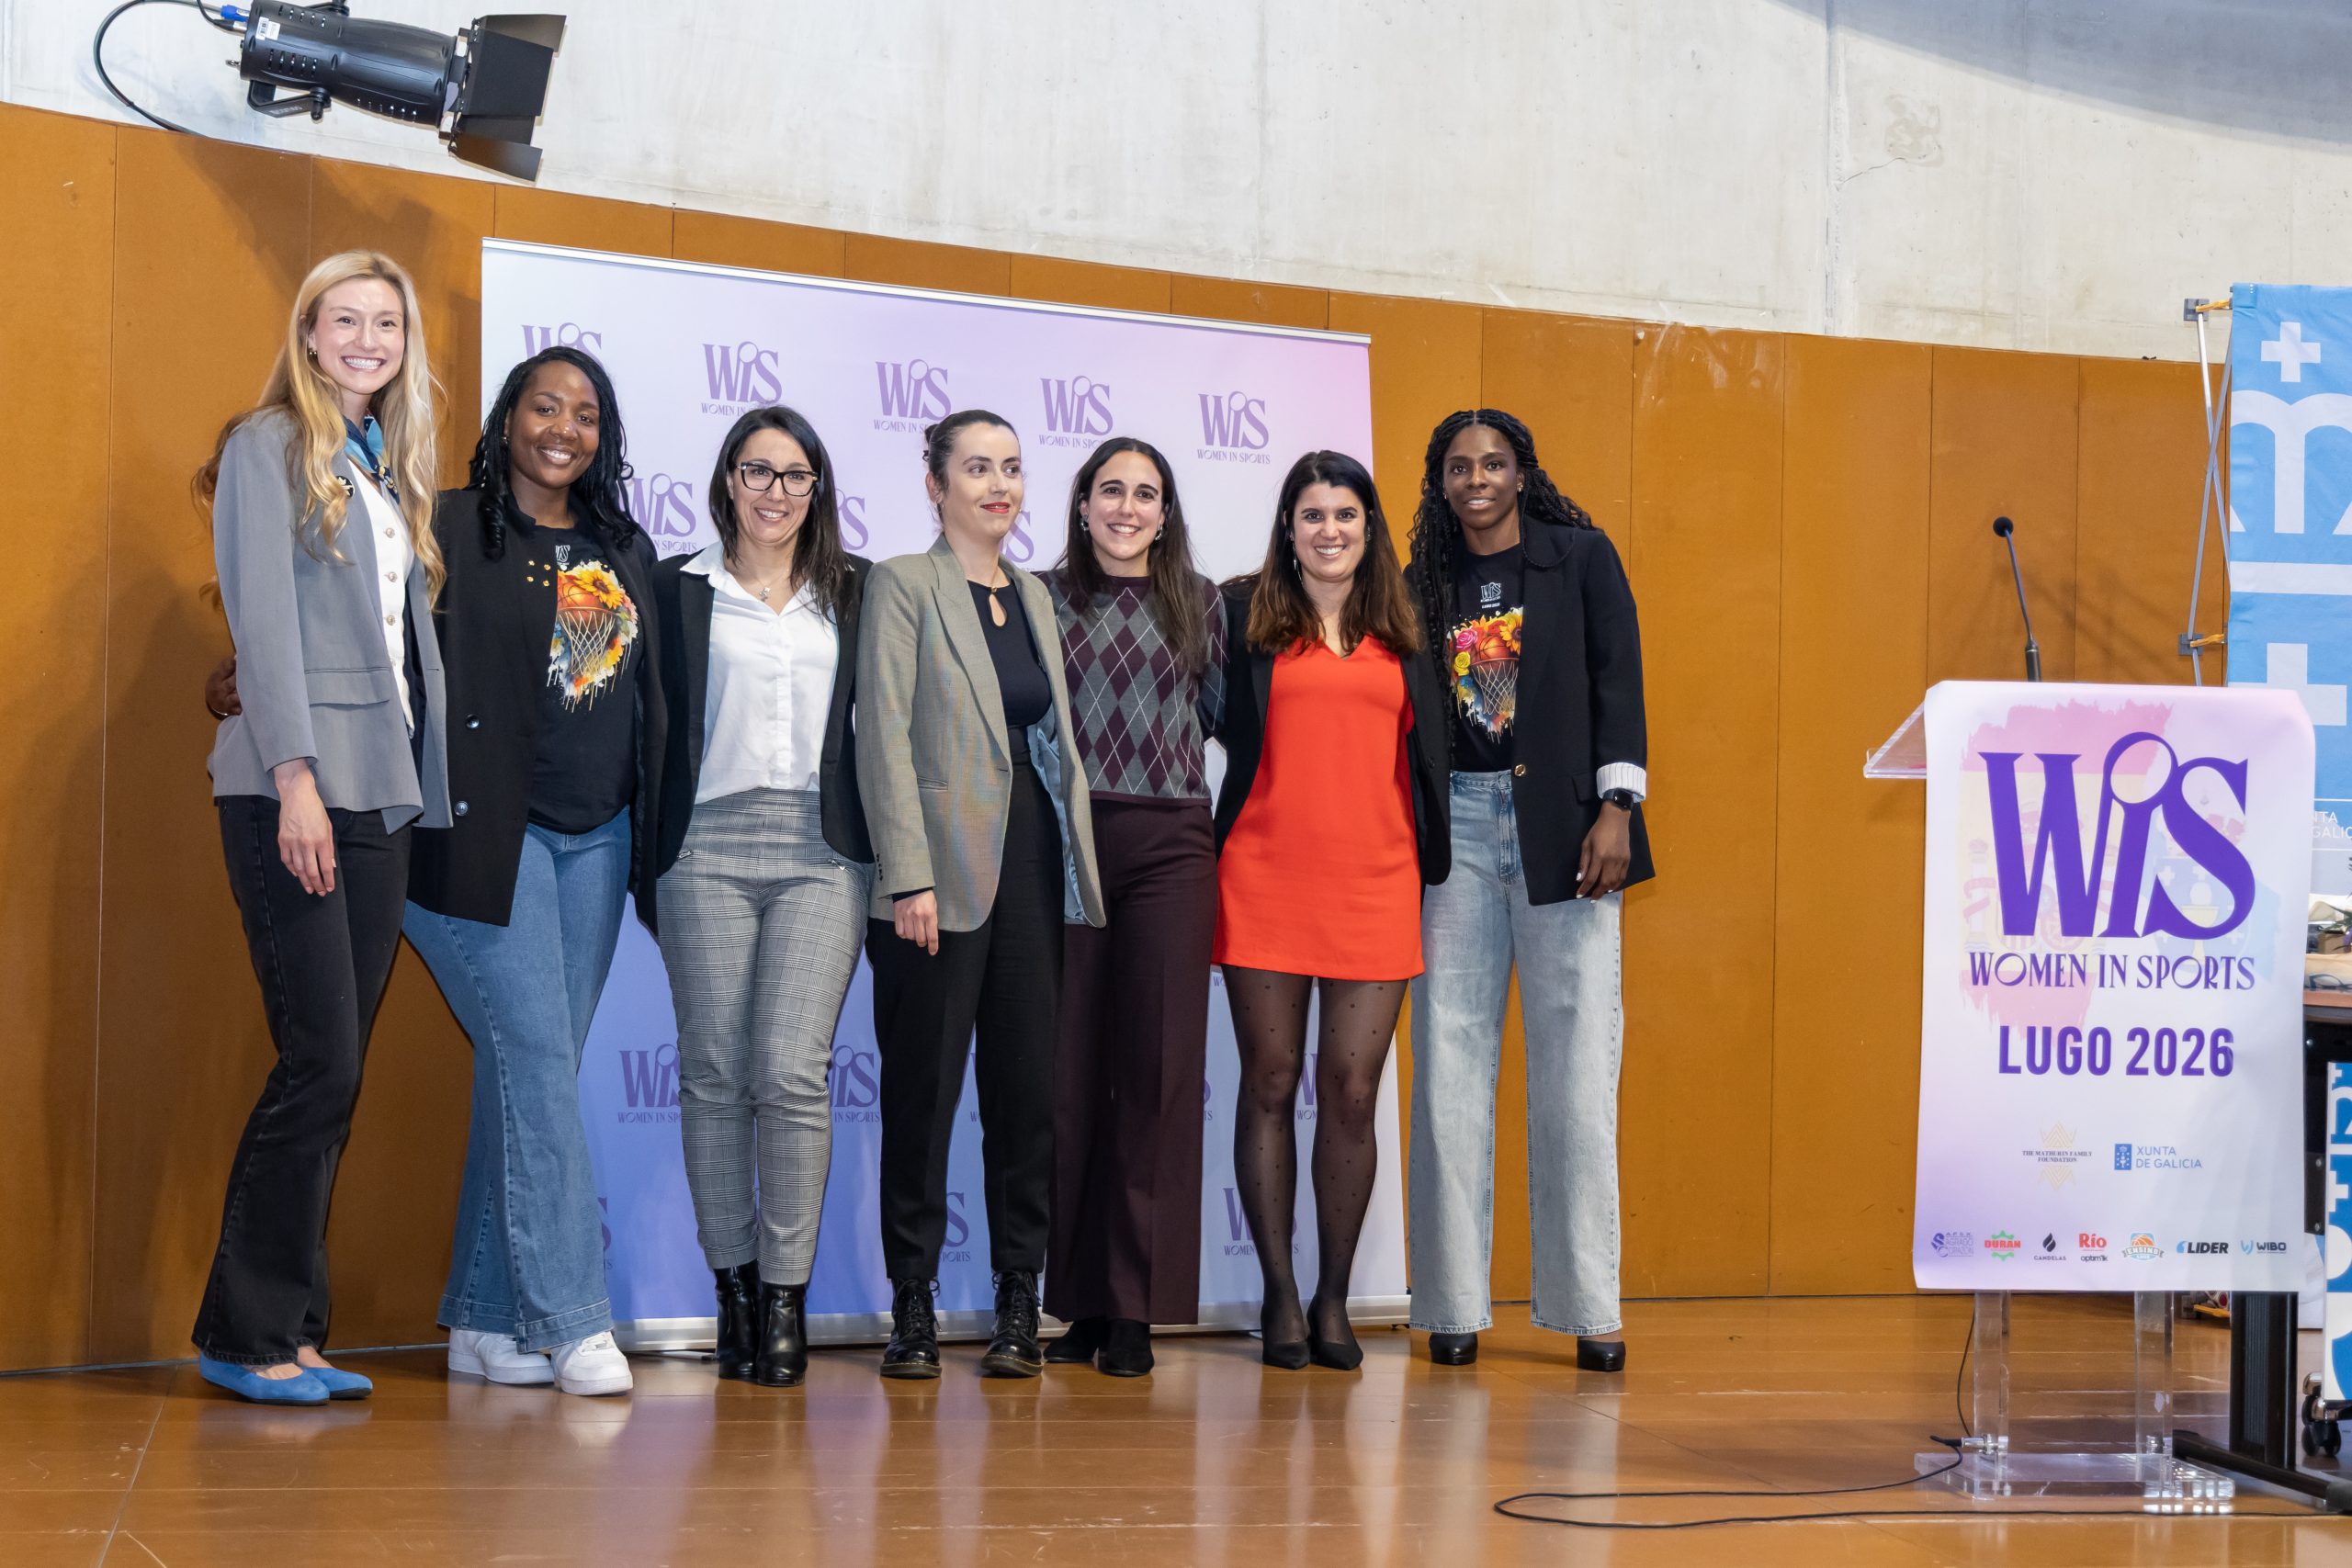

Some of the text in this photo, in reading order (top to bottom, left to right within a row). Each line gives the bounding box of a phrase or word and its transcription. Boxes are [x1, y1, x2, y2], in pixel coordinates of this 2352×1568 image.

[701, 402, 735, 416] WOMEN
[874, 419, 906, 433] WOMEN
[908, 423, 917, 434] IN
[1039, 434, 1070, 447] WOMEN
[1072, 437, 1081, 448] IN
[1197, 449, 1271, 465] WOMEN IN SPORTS
[662, 539, 698, 552] SPORTS
[1969, 951, 2256, 990] WOMEN IN SPORTS
[1998, 1025, 2233, 1077] LUGO 2026
[617, 1111, 653, 1123] WOMEN
[655, 1111, 666, 1122] IN
[834, 1111, 880, 1122] IN SPORTS
[2136, 1145, 2177, 1156] XUNTA
[2136, 1158, 2202, 1168] DE GALICIA
[2187, 1241, 2230, 1254] LIDER
[2256, 1241, 2287, 1251] WIBO
